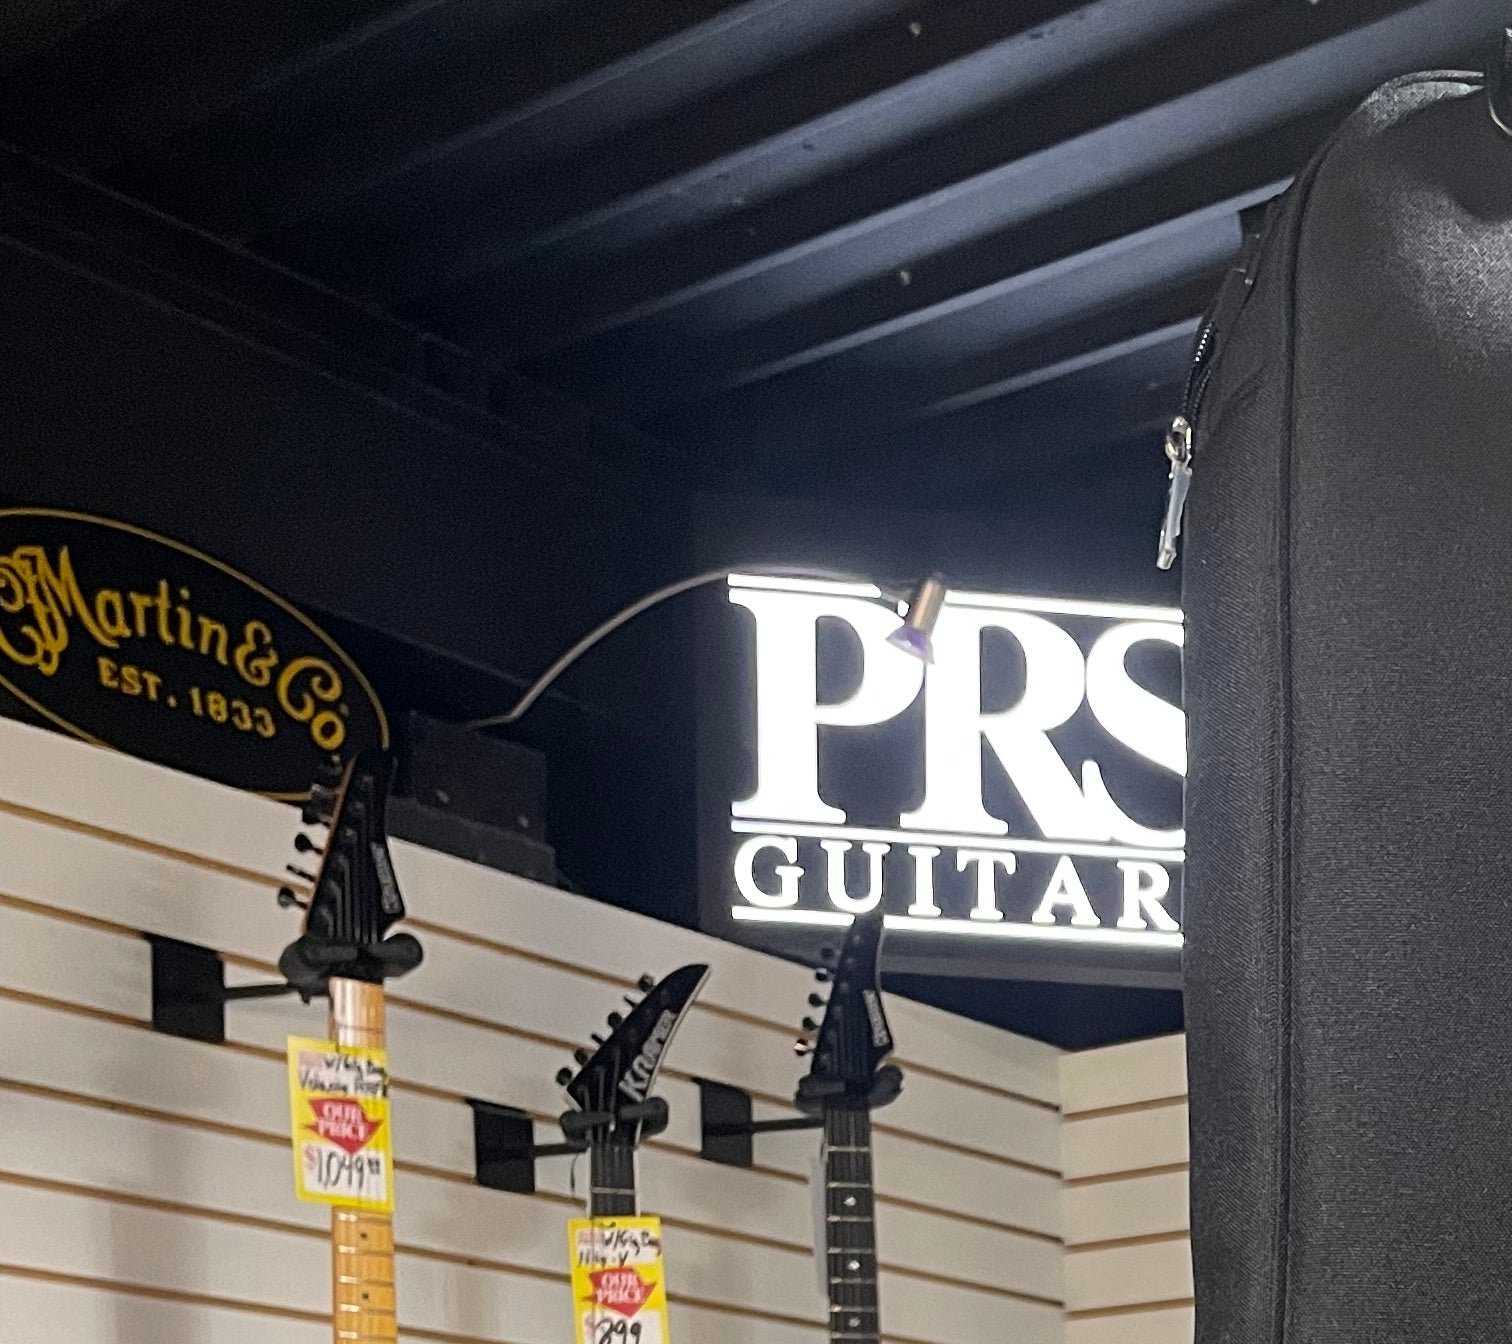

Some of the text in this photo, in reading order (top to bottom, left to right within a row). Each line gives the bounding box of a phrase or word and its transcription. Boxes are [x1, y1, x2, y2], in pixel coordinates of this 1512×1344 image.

[96, 656, 277, 739] EST. 1833
[728, 588, 1188, 848] PRS
[322, 1101, 364, 1125] OUR
